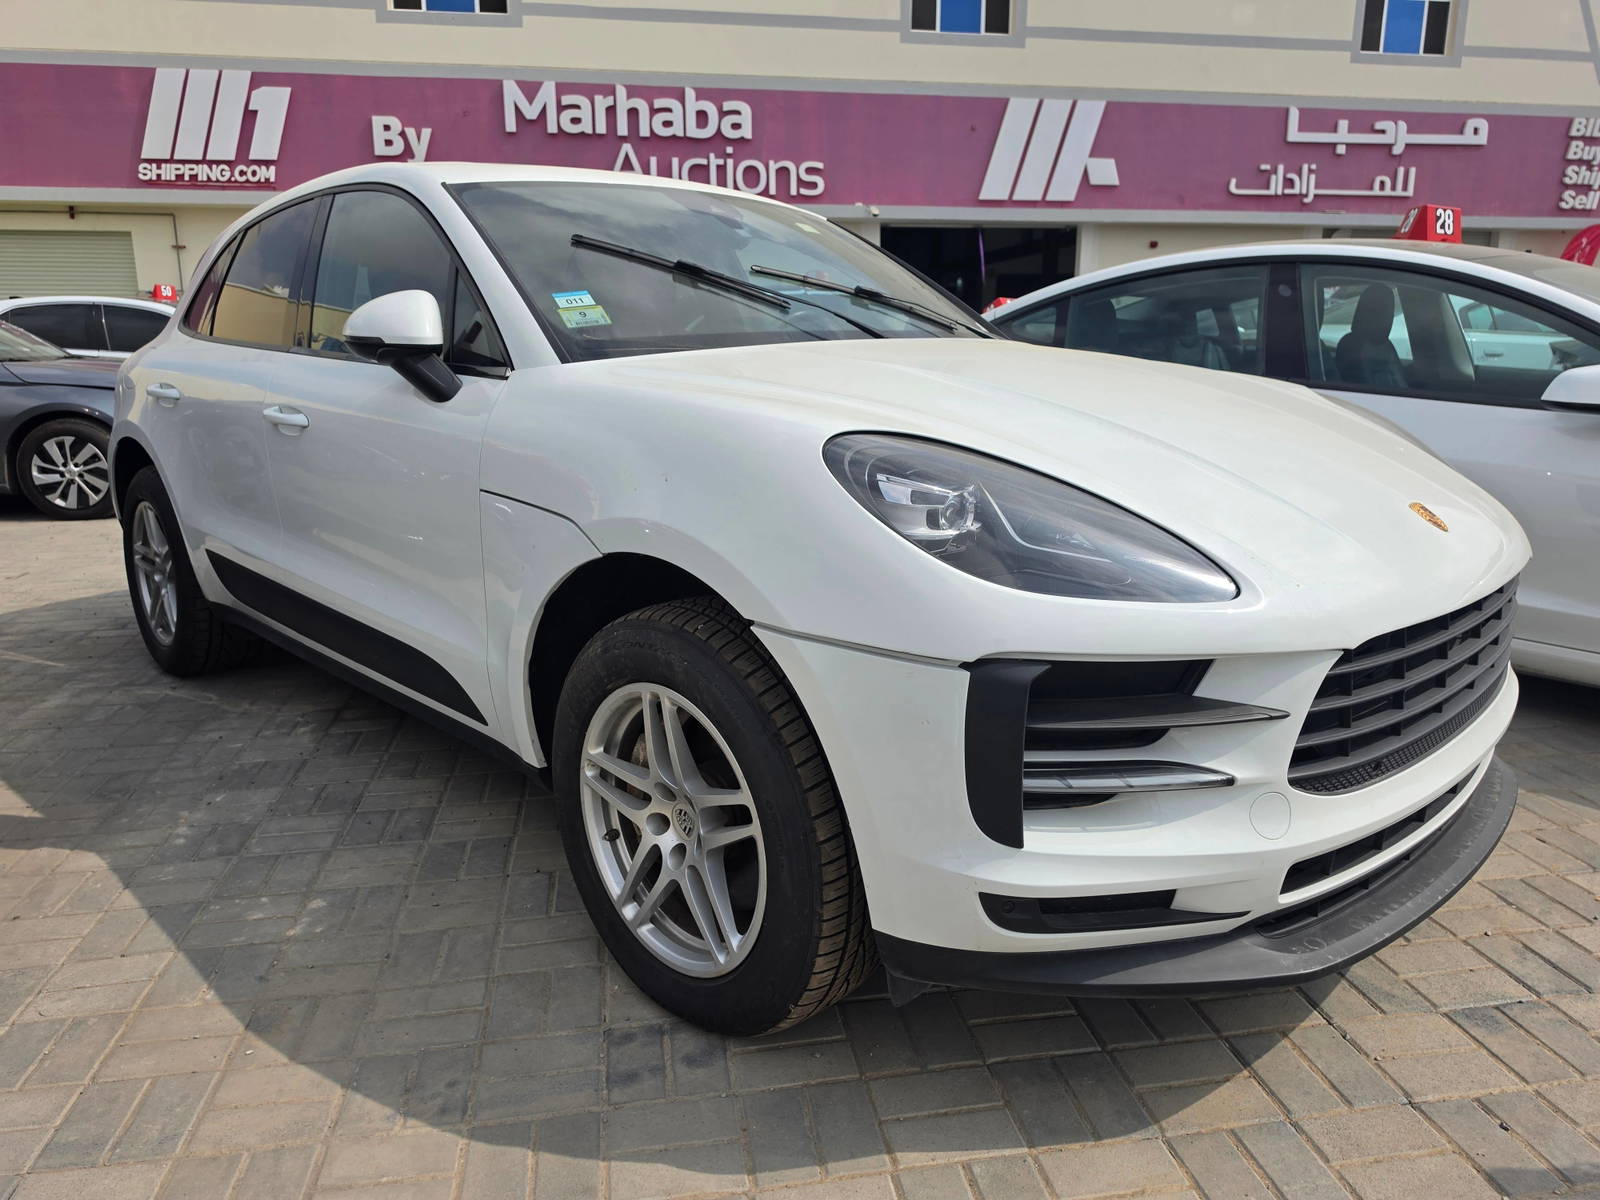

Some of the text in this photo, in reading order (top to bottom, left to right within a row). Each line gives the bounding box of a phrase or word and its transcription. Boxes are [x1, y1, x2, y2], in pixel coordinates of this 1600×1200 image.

[503, 80, 752, 139] Marhaba
[372, 116, 432, 162] By
[1287, 106, 1489, 155] مرحبا
[138, 163, 276, 182] SHIPPING.COM
[613, 143, 825, 196] Auctions
[1229, 164, 1416, 203] للمزادات
[1559, 190, 1600, 210] Sell
[1436, 208, 1454, 235] 28
[161, 285, 172, 297] 50
